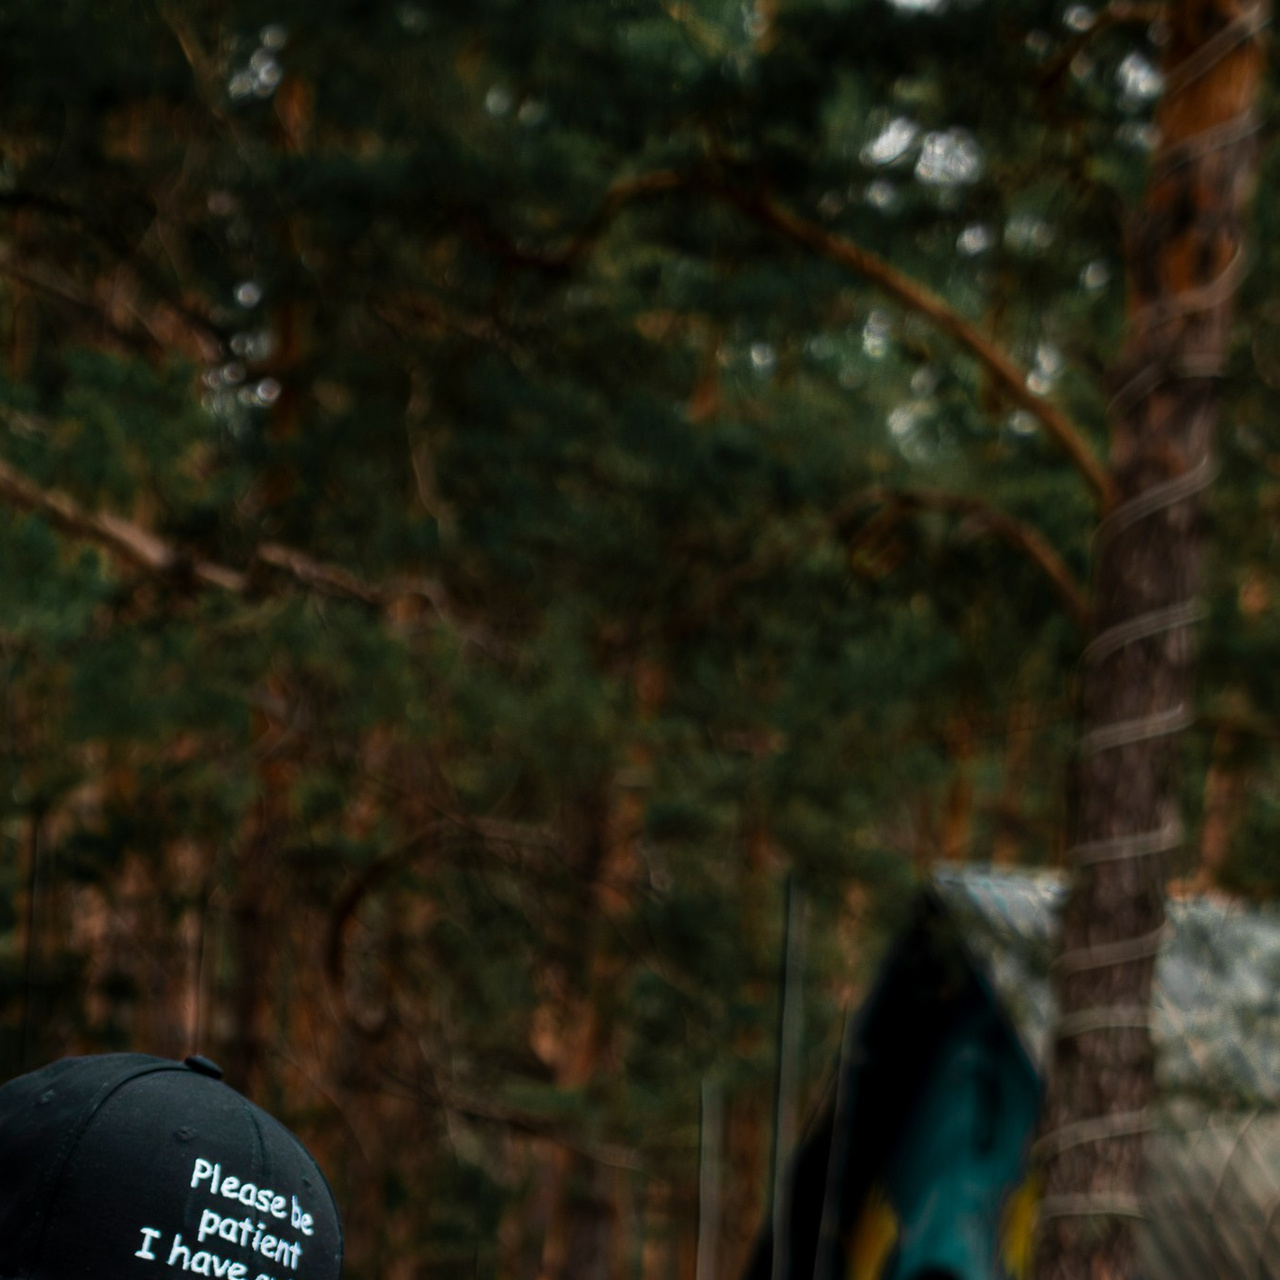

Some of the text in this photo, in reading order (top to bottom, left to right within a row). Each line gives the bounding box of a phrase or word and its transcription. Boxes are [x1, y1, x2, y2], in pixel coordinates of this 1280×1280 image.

[191, 1158, 314, 1236] Please be
[134, 1227, 161, 1260] I
[198, 1209, 303, 1270] patient
